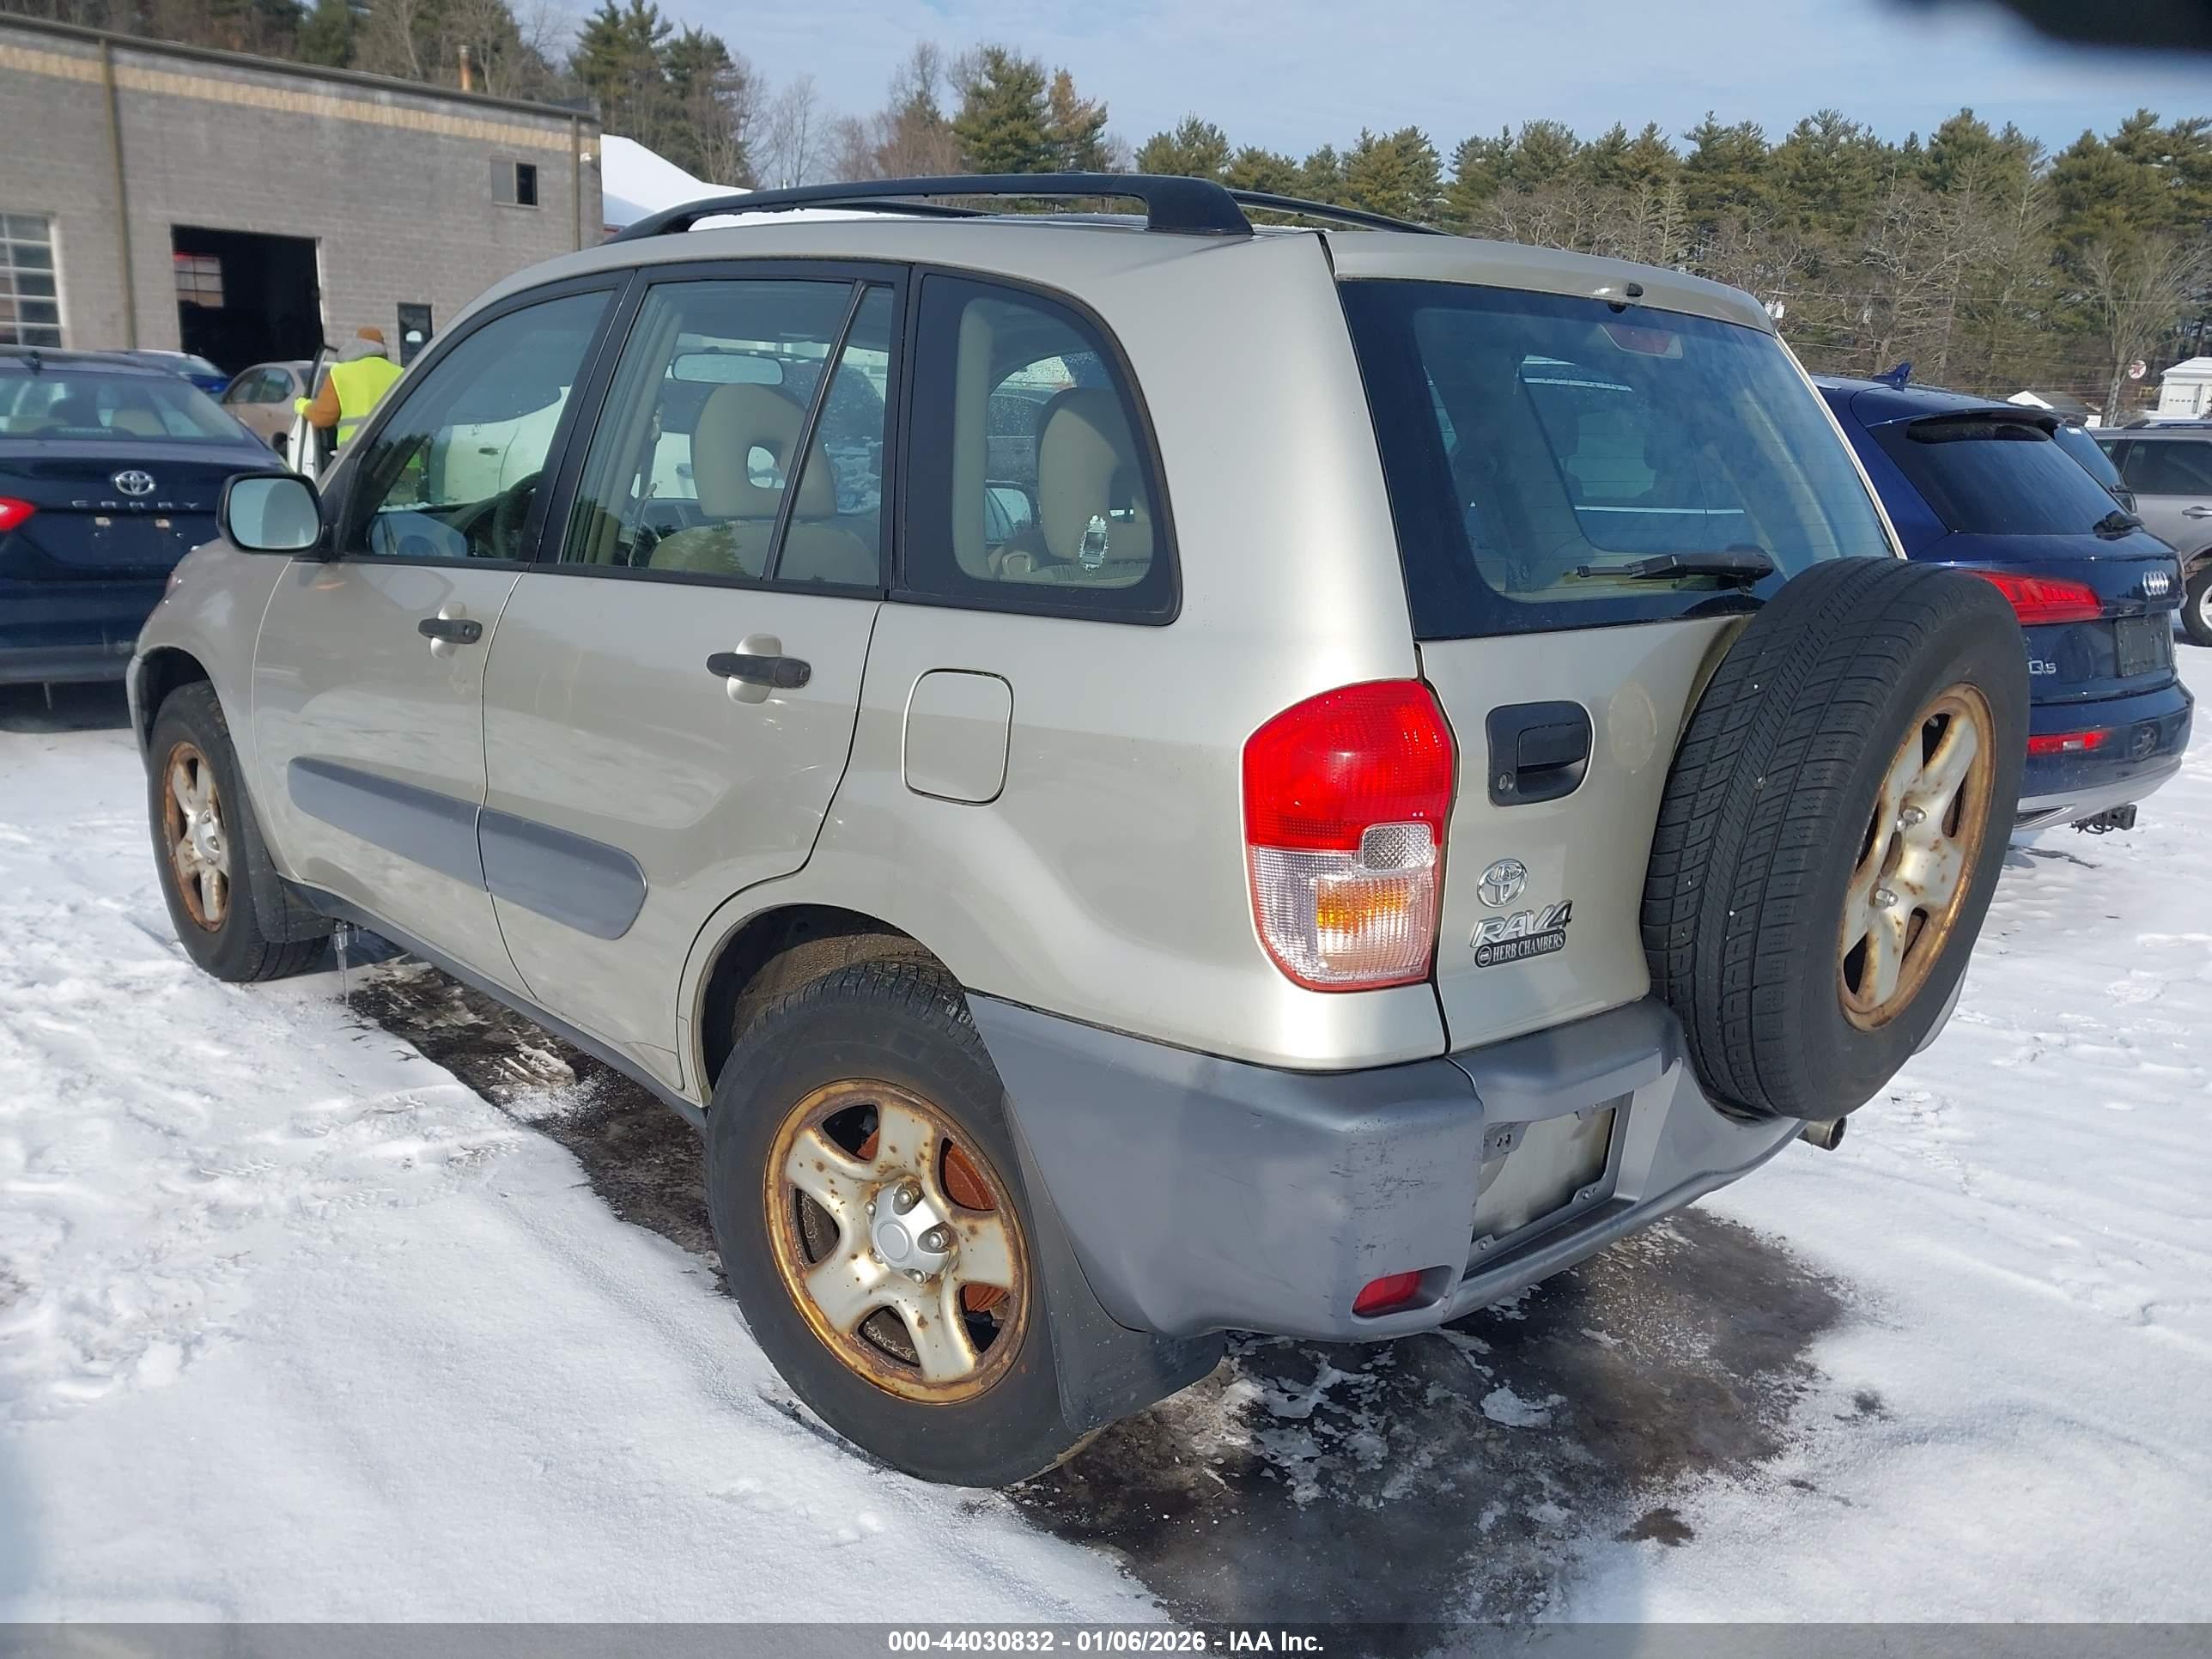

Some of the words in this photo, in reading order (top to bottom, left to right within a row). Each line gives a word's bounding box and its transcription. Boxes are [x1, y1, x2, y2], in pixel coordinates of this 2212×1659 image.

[2027, 659, 2057, 675] Q5
[1470, 899, 1573, 948] RAV4
[1492, 943, 1517, 962] HERB
[1517, 932, 1564, 957] CHAMBERS
